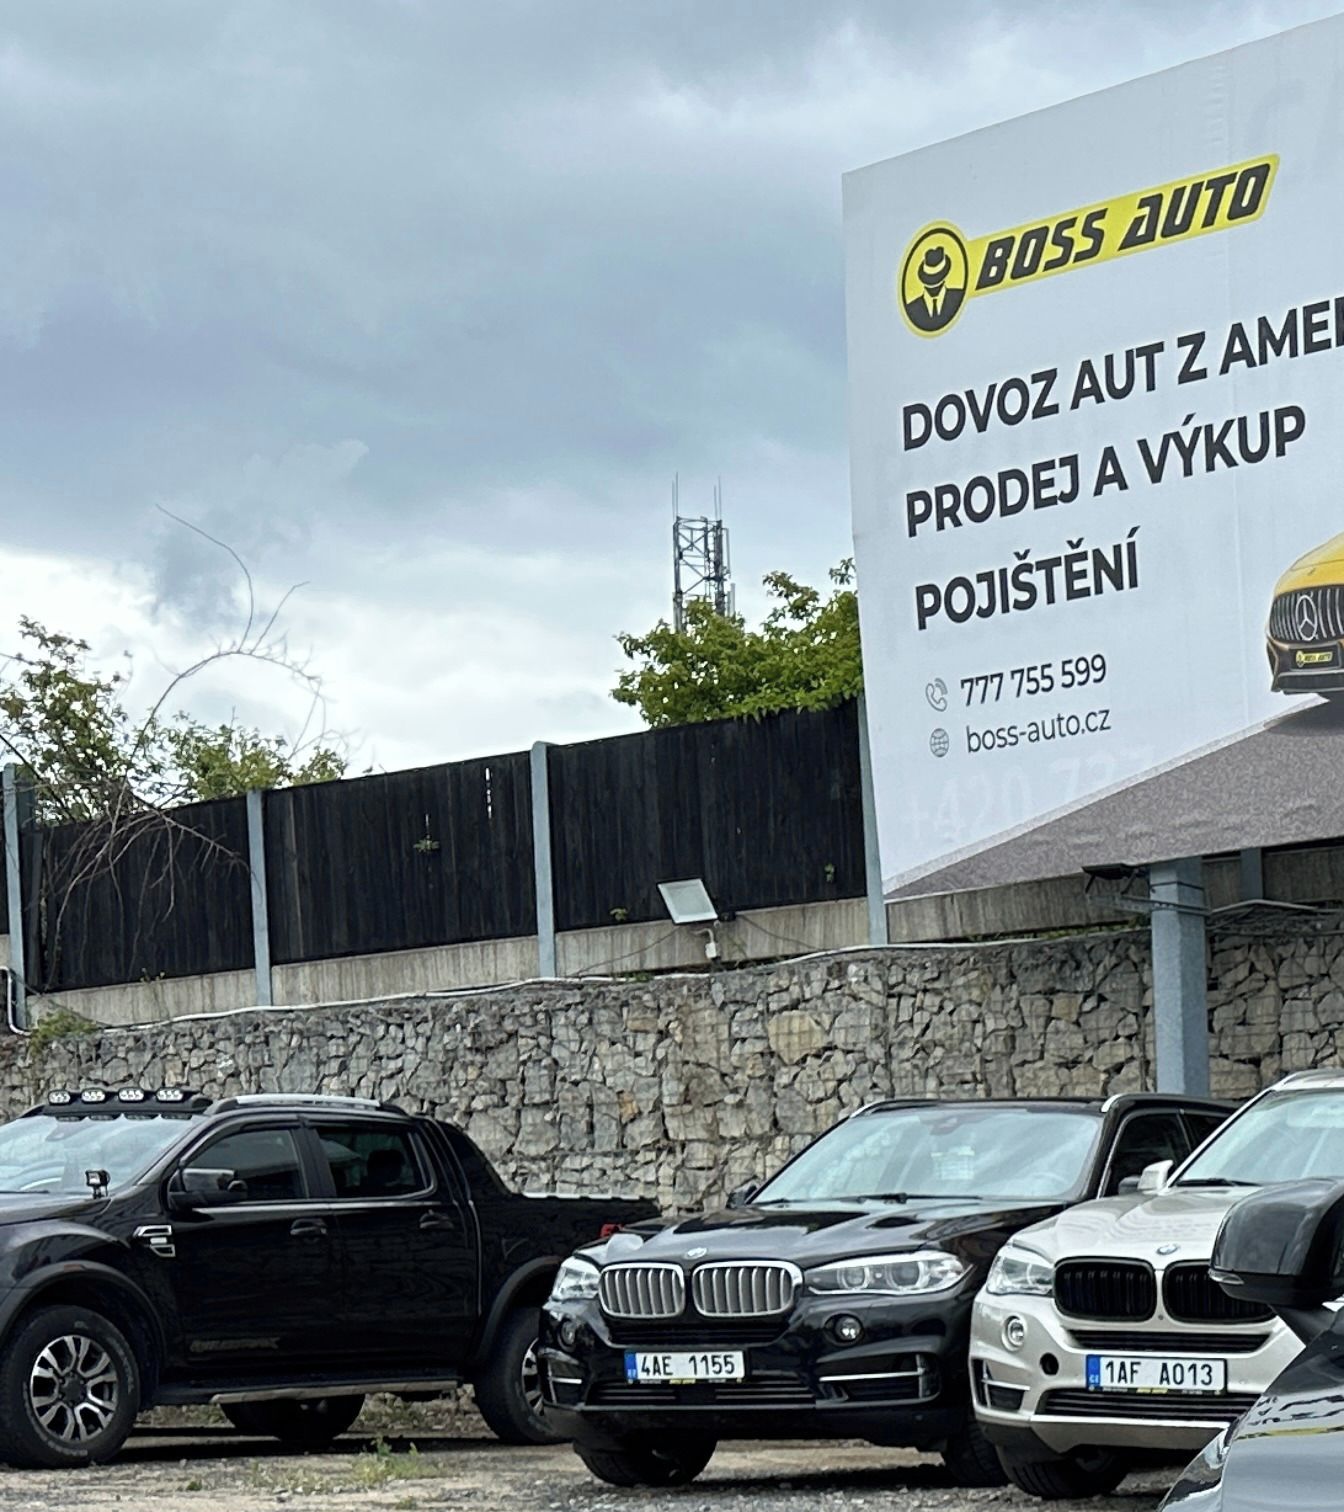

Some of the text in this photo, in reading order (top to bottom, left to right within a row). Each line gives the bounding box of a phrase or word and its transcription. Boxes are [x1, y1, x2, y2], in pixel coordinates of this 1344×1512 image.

[975, 163, 1271, 291] BOSS AUTO
[903, 367, 1060, 452] DOVOZ
[1069, 341, 1165, 410] AUT
[1177, 331, 1208, 385] Z
[906, 405, 1306, 538] PRODEJ A VÝKUP
[915, 525, 1141, 631] POJIŠTĚNÍ
[960, 653, 1107, 707] 777 755 599
[966, 708, 1112, 753] boss-auto.cz
[641, 1354, 736, 1376] 4AE 1155
[1105, 1360, 1213, 1386] 1AF A013
